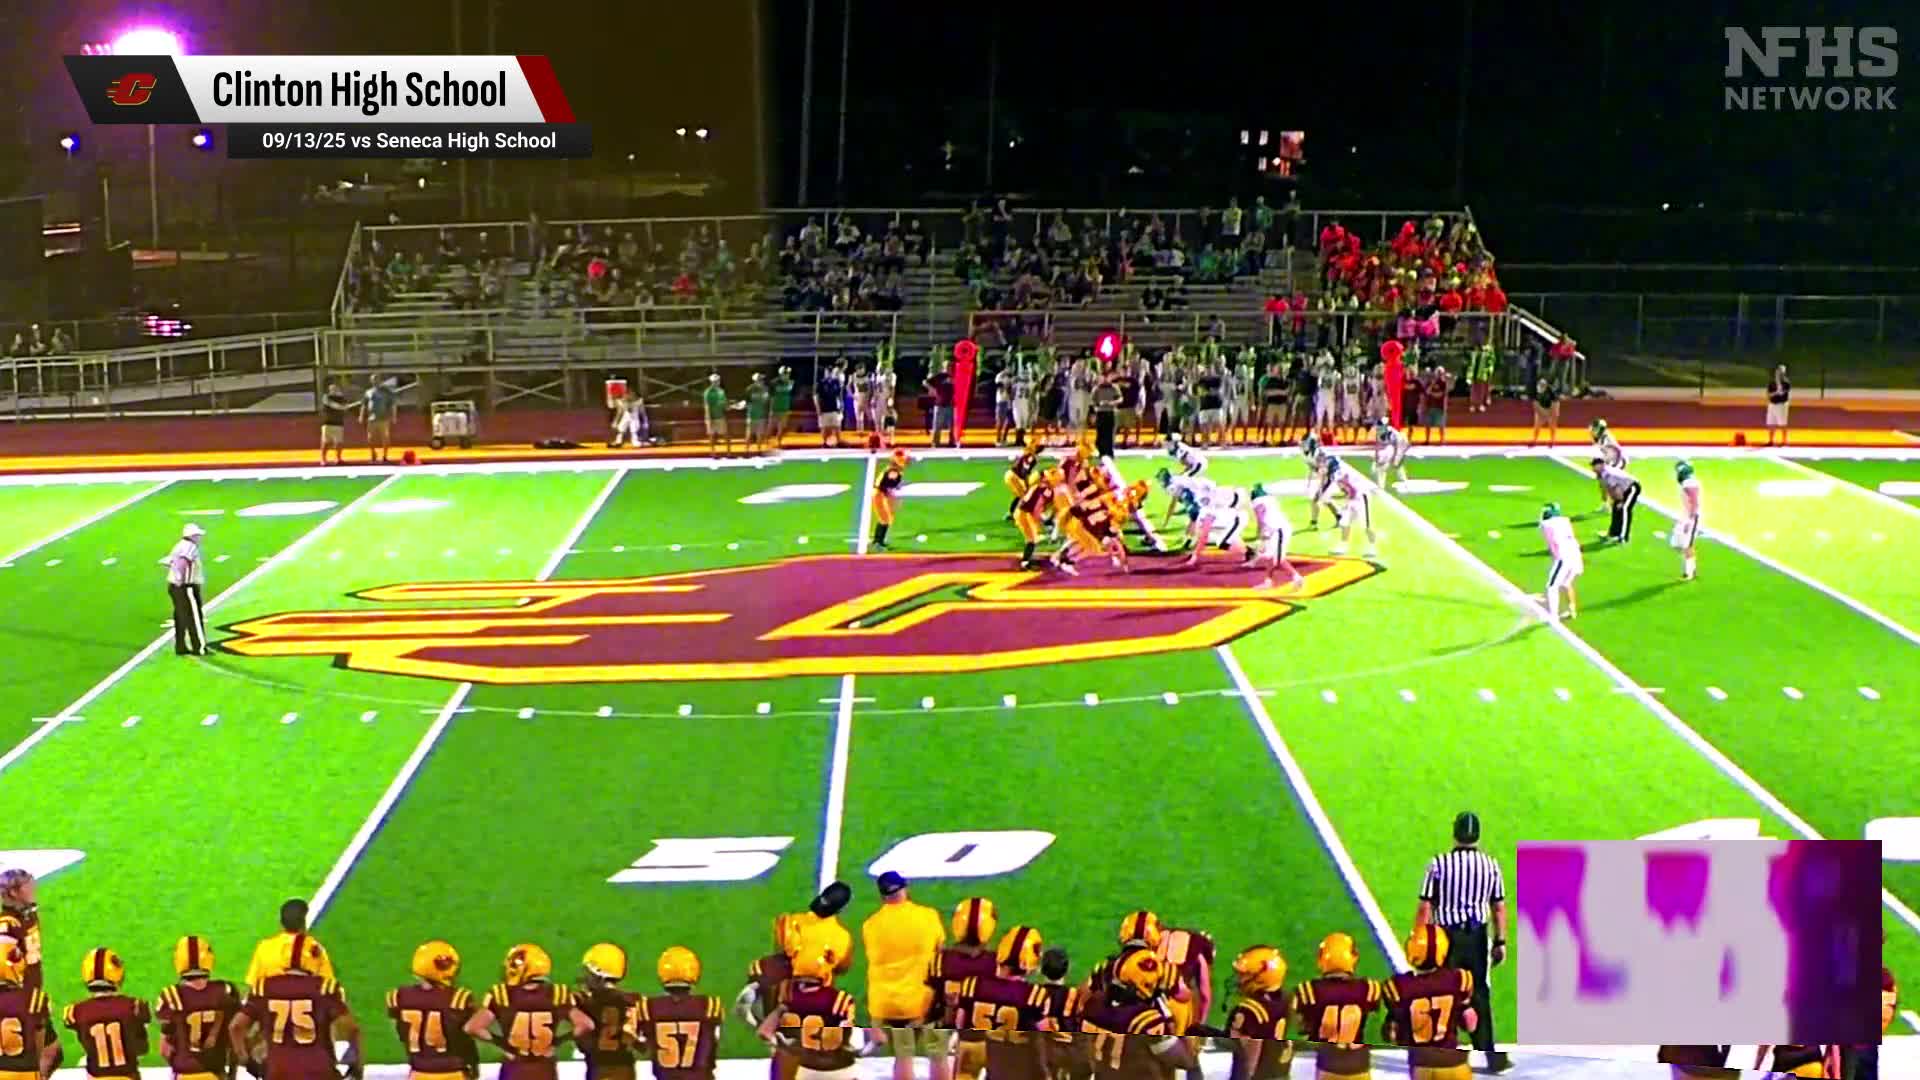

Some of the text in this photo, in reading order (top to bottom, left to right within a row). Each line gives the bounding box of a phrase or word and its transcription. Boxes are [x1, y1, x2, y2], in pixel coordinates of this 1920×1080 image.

[1100, 335, 1114, 358] 4
[0, 1017, 24, 1057] 6
[186, 1010, 224, 1052] 17
[268, 1000, 316, 1044] 75
[401, 1010, 447, 1053] 74
[508, 1011, 554, 1057] 45
[90, 1021, 126, 1068] 11
[655, 1021, 700, 1068] 57
